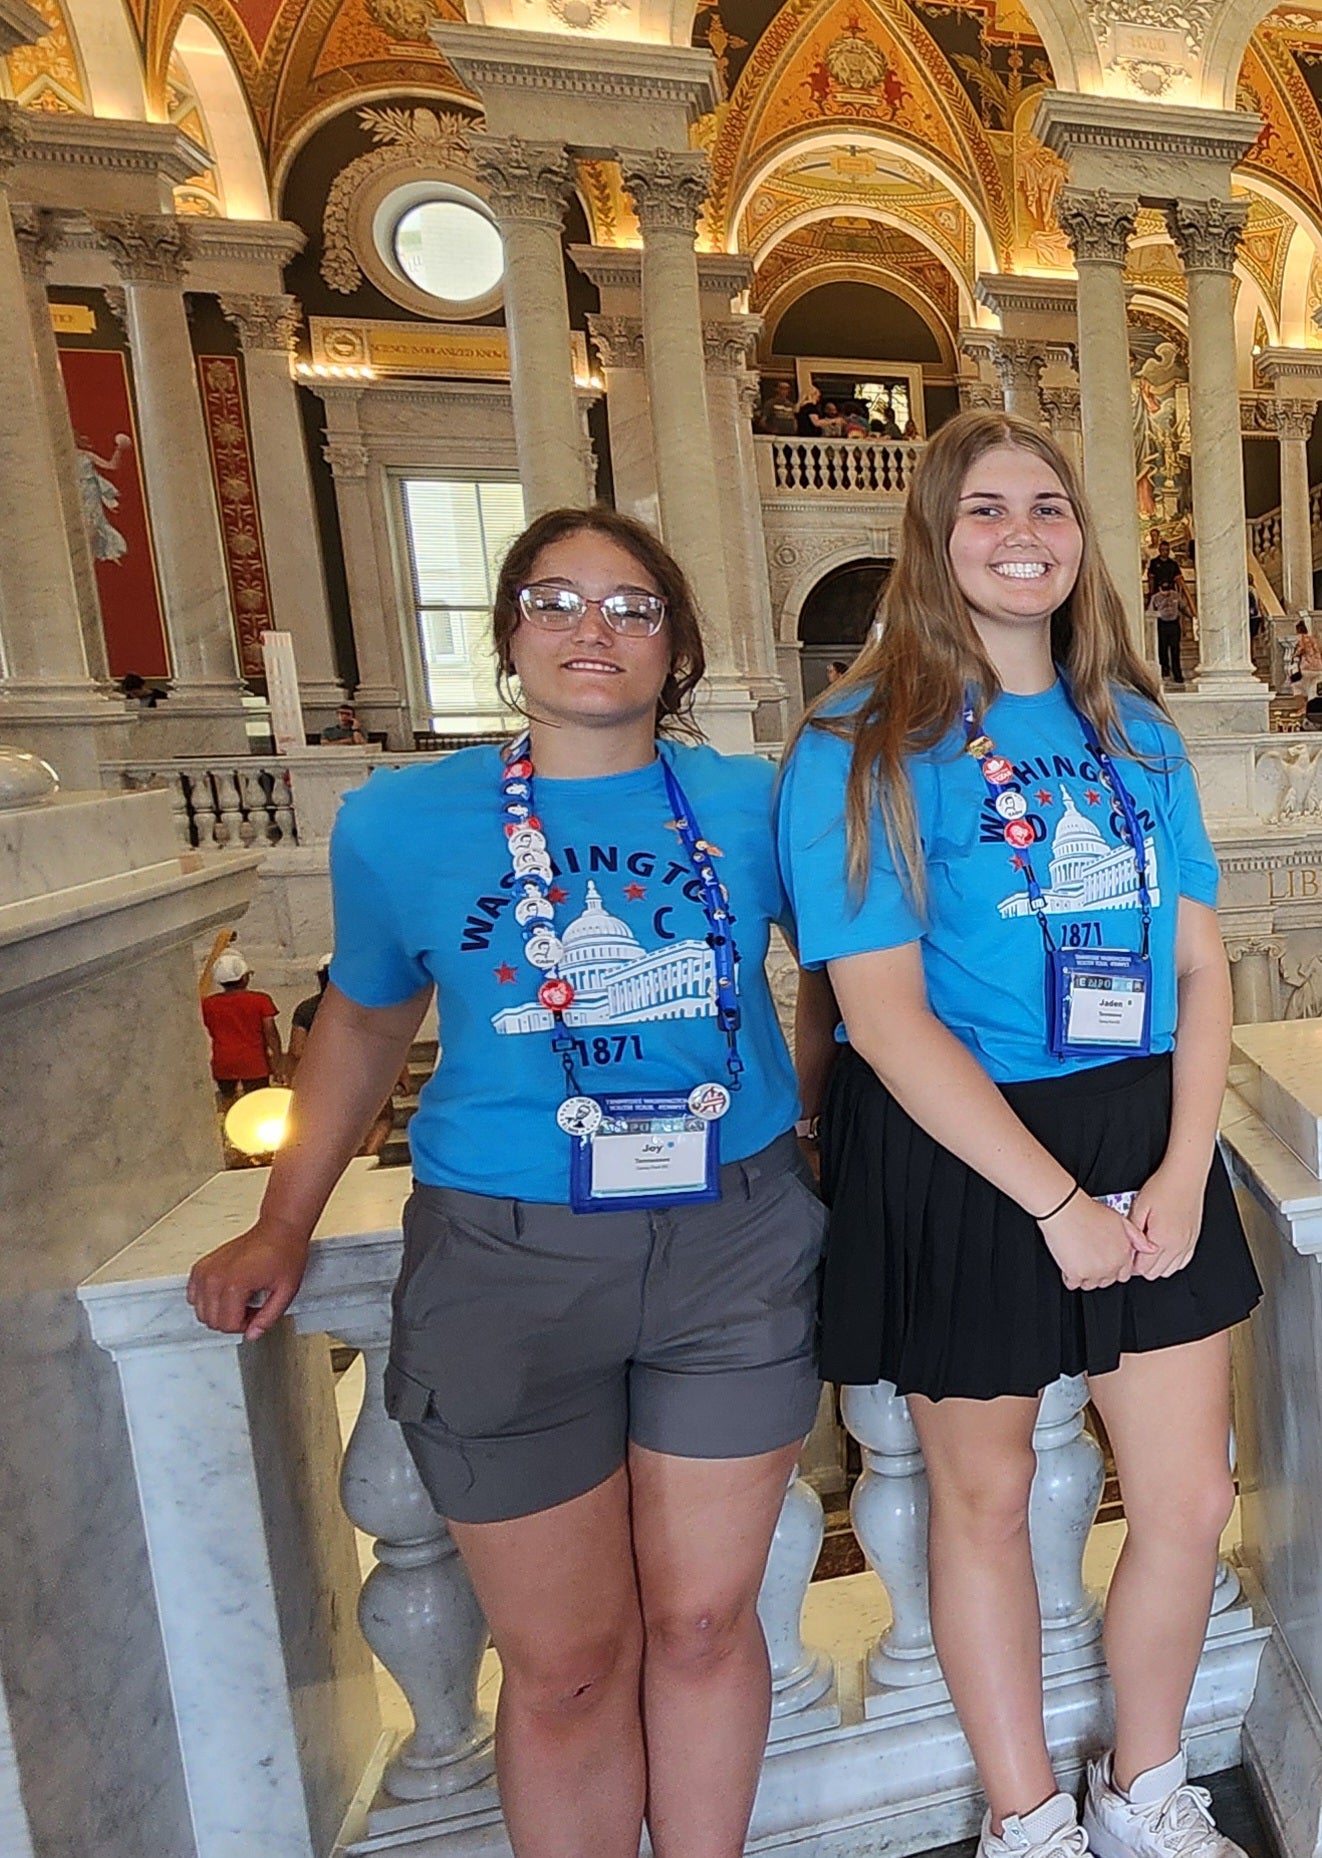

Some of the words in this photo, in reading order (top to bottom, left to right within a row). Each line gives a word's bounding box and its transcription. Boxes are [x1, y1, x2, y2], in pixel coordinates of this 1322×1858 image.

[1061, 922, 1103, 947] 1871
[1099, 999, 1124, 1008] Jaden
[575, 1034, 644, 1067] 1871
[642, 1143, 664, 1154] Joy
